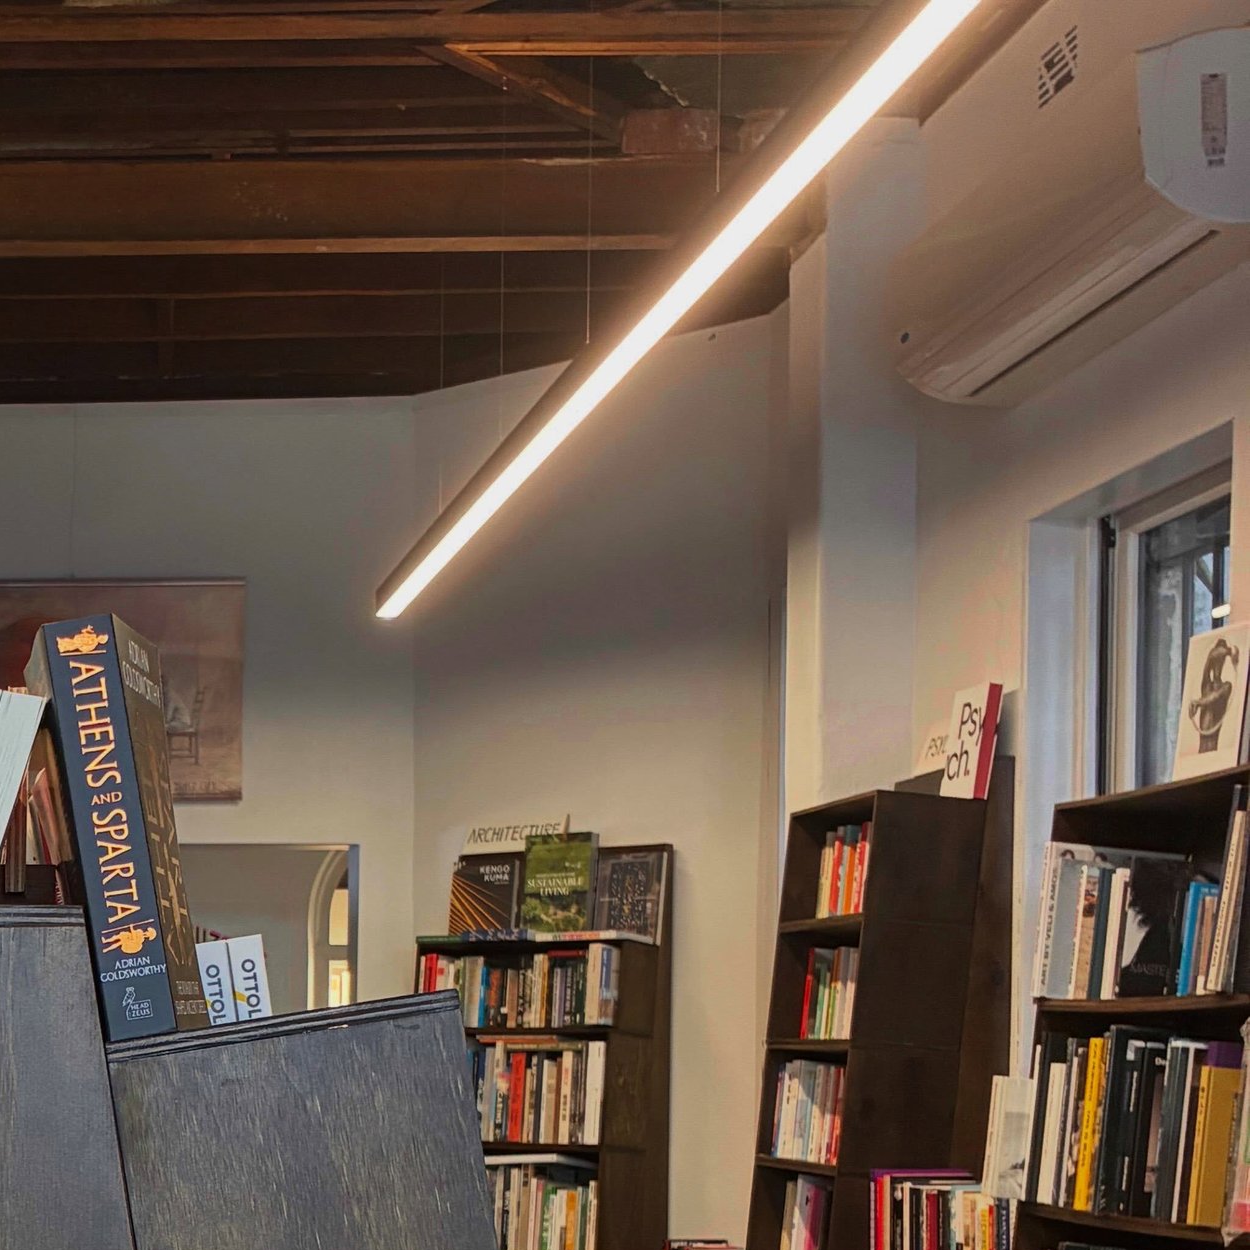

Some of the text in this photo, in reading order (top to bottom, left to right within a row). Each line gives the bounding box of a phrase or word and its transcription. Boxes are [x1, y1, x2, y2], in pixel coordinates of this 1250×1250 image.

[69, 661, 141, 924] ATHENS AND SPARTA
[467, 823, 561, 844] ARCHITECTURE
[479, 864, 510, 875] KENGO
[484, 873, 510, 882] KUMA
[527, 877, 584, 889] SUSTAINABLE
[540, 886, 570, 897] LIVING
[114, 956, 151, 970] ADRIAN
[100, 963, 167, 983] GOLDSWORTHY
[206, 964, 227, 1024] OTTOL
[241, 959, 262, 1018] OTTOL
[130, 1002, 150, 1011] HEAD
